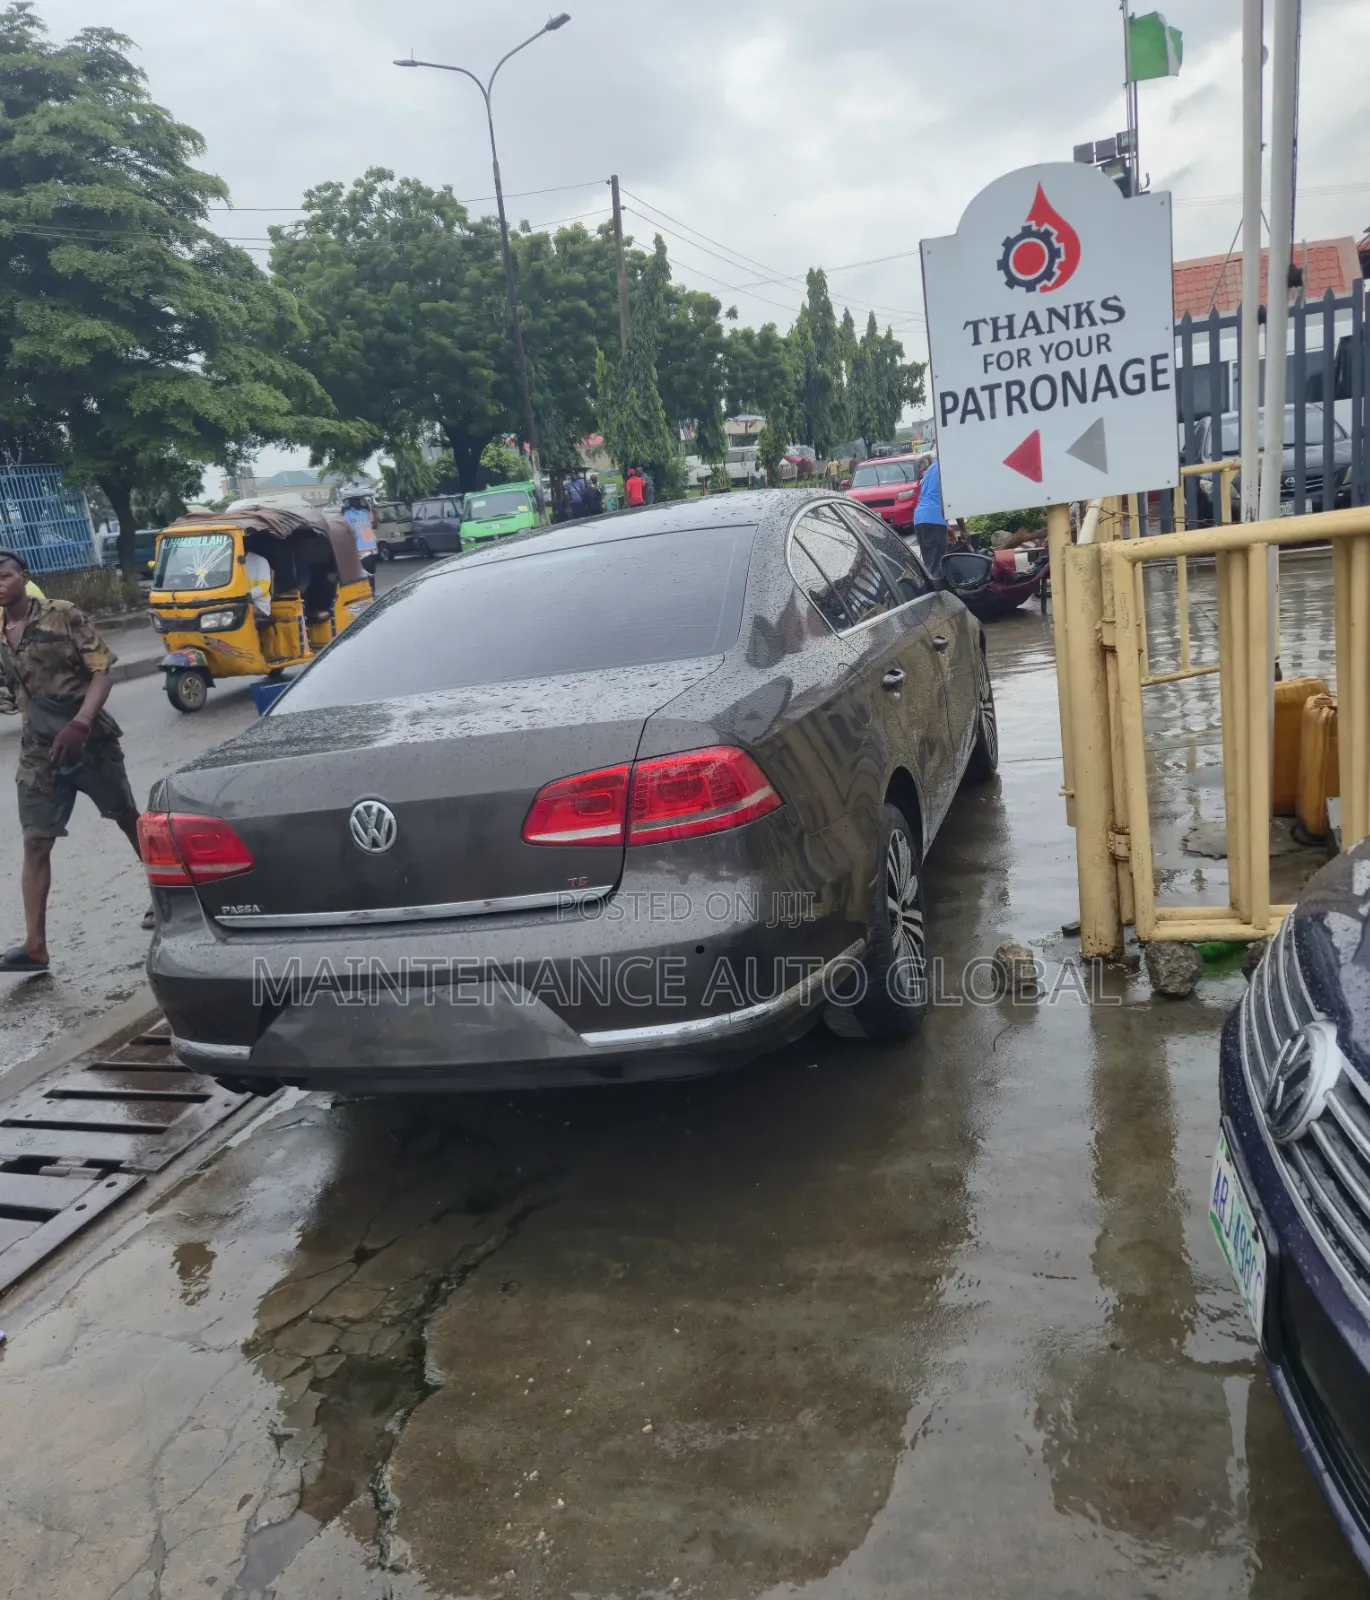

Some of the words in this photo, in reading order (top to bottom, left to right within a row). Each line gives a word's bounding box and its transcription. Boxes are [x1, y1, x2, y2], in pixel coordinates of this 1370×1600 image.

[963, 295, 1126, 346] THANKS
[982, 347, 1032, 375] FOR
[1039, 333, 1112, 364] YOUR
[939, 353, 1171, 427] PATRONAGE
